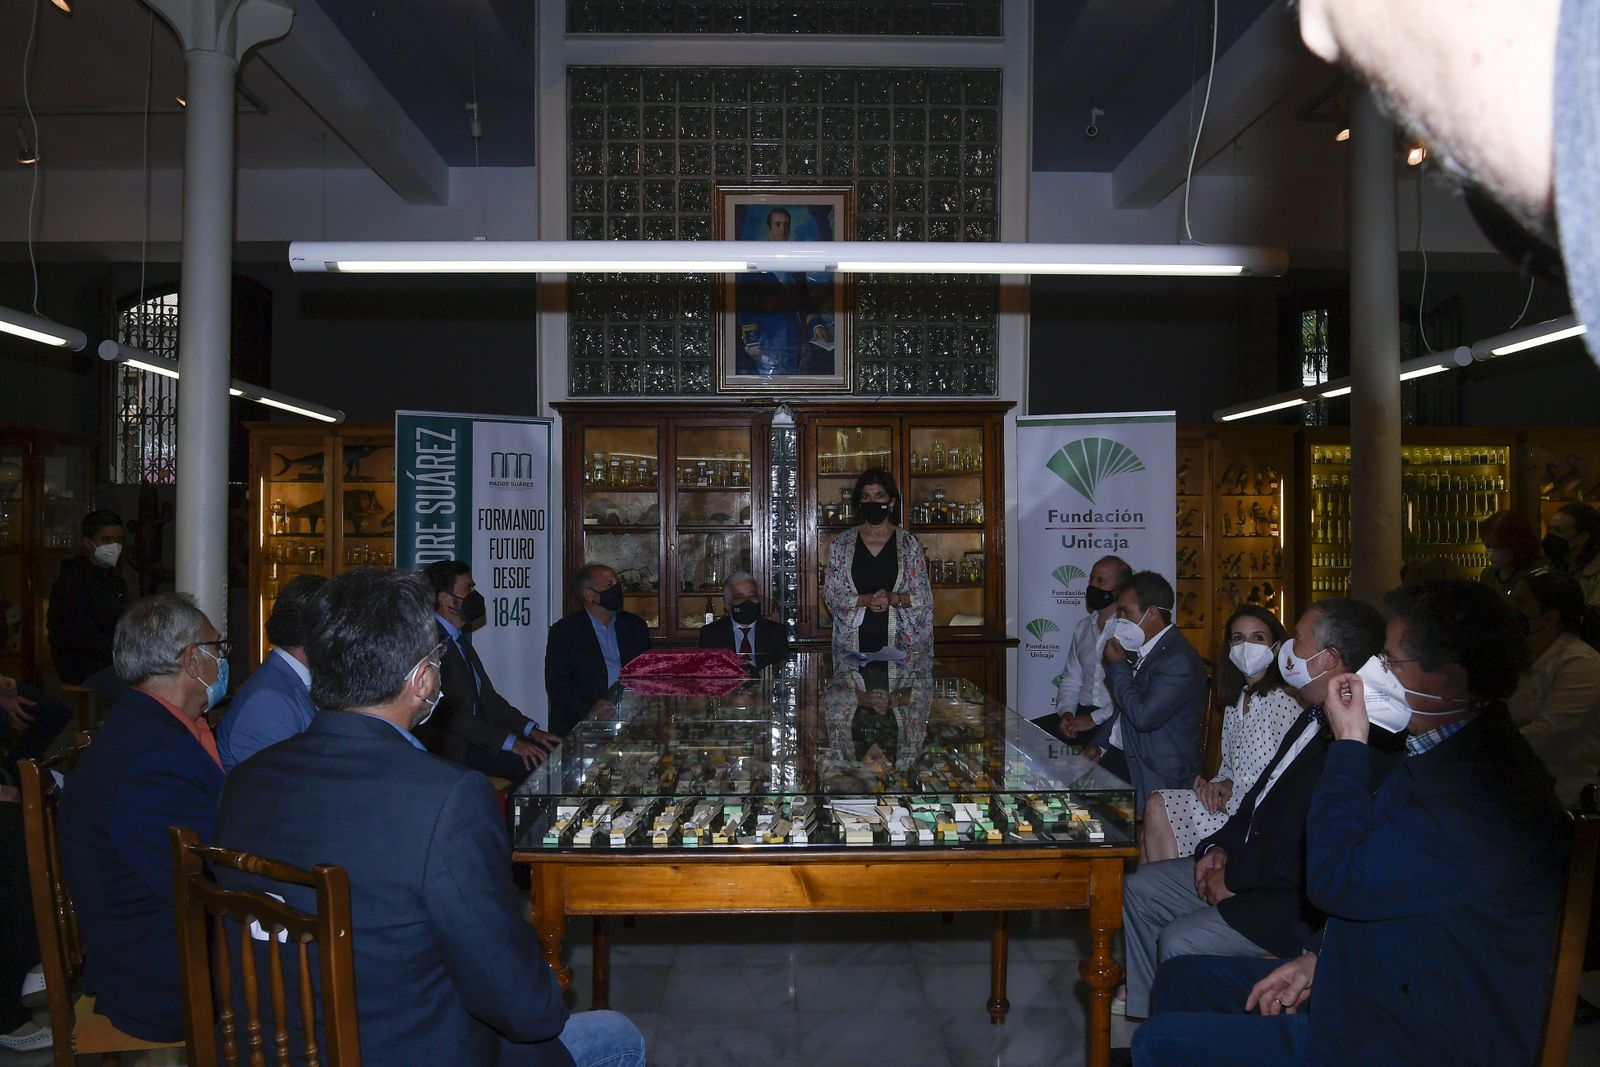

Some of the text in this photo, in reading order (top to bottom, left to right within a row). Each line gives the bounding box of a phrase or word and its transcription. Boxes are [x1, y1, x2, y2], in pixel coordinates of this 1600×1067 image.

[406, 427, 456, 568] DRE SUÁREZ
[478, 508, 545, 531] FORMANDO
[1048, 509, 1144, 523] Fundación
[489, 538, 535, 560] FUTURO
[1061, 532, 1130, 552] Unicaja
[493, 566, 531, 589] DESDE
[493, 597, 531, 627] 1845
[1030, 651, 1055, 659] Unicaja
